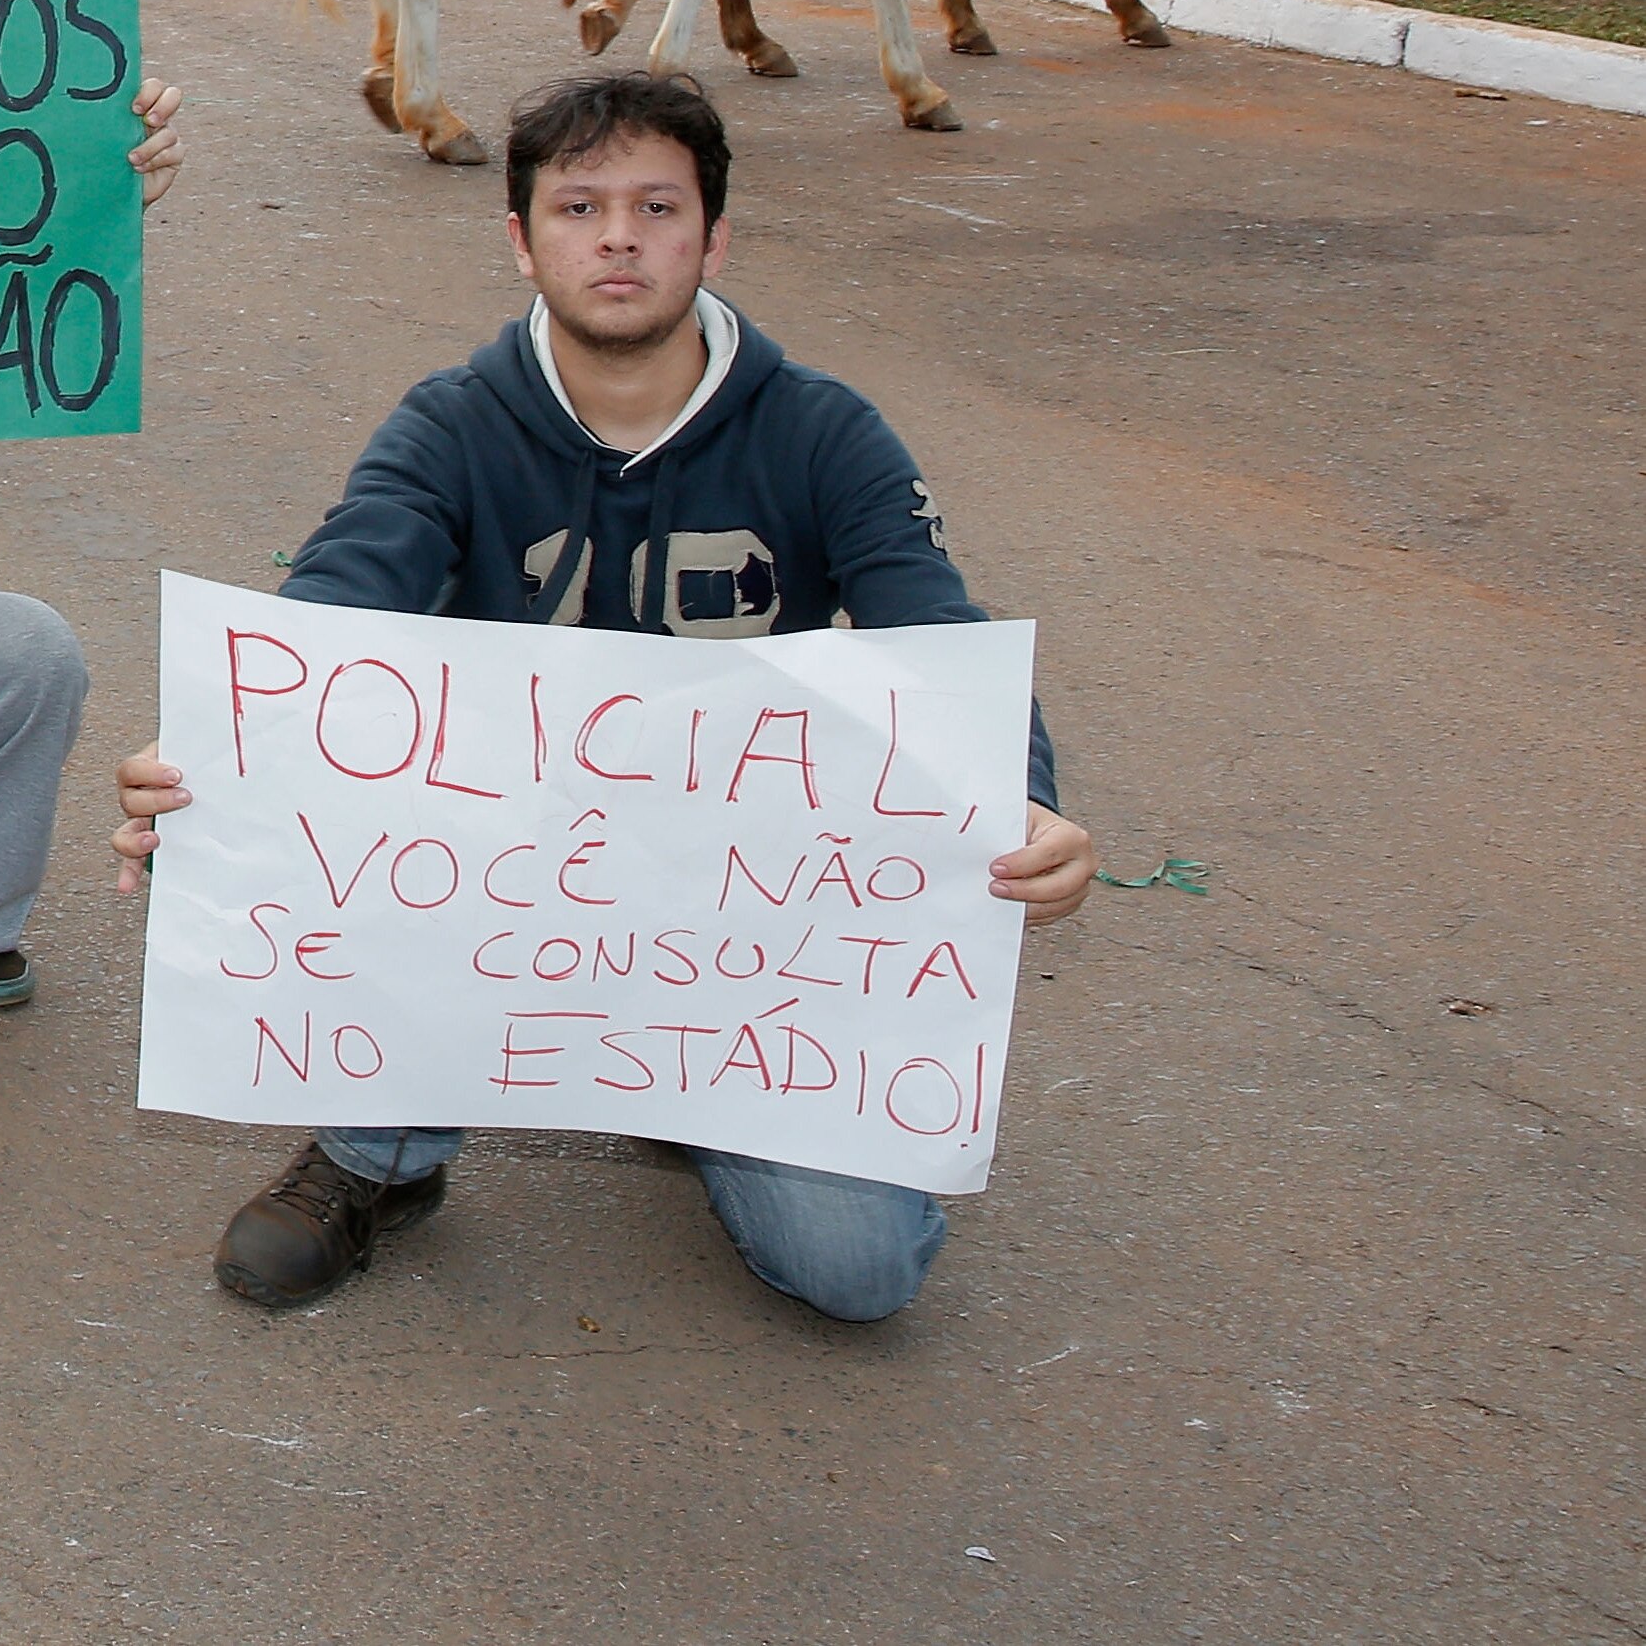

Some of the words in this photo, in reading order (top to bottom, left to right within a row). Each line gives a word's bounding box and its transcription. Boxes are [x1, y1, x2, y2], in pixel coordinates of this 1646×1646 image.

[225, 626, 978, 835] POLICIAL,
[297, 809, 618, 910] VOCÊ
[717, 832, 927, 912] NÃO
[219, 901, 357, 981] SE
[472, 922, 977, 1001] CONSULTA
[253, 1010, 386, 1087] NO
[487, 997, 991, 1150] ESTÁDIO!
